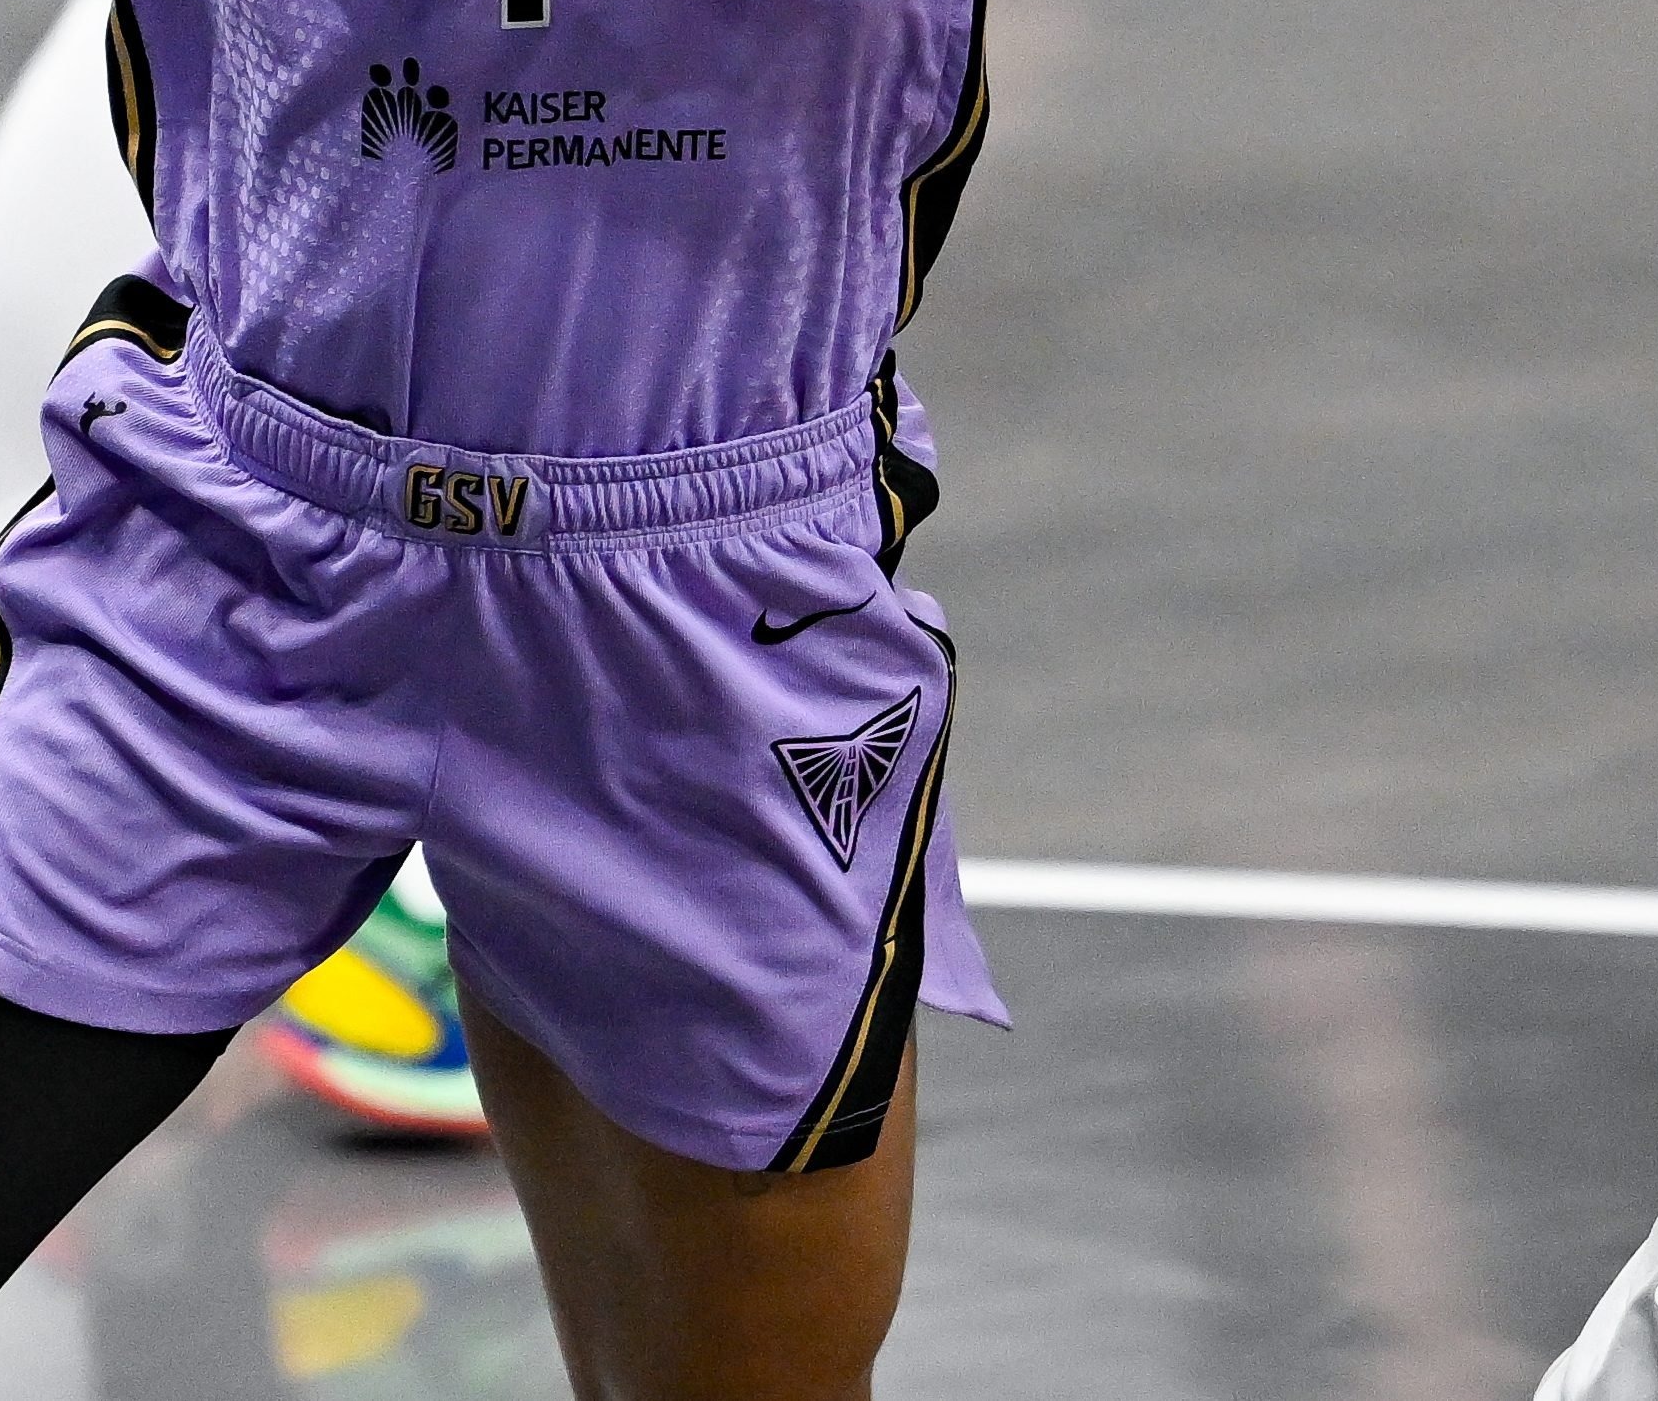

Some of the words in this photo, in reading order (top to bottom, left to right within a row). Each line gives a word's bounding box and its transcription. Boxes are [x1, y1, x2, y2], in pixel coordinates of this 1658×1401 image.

[483, 90, 608, 125] KAISER
[482, 128, 728, 170] PERMANENTE
[404, 463, 530, 536] GSV
